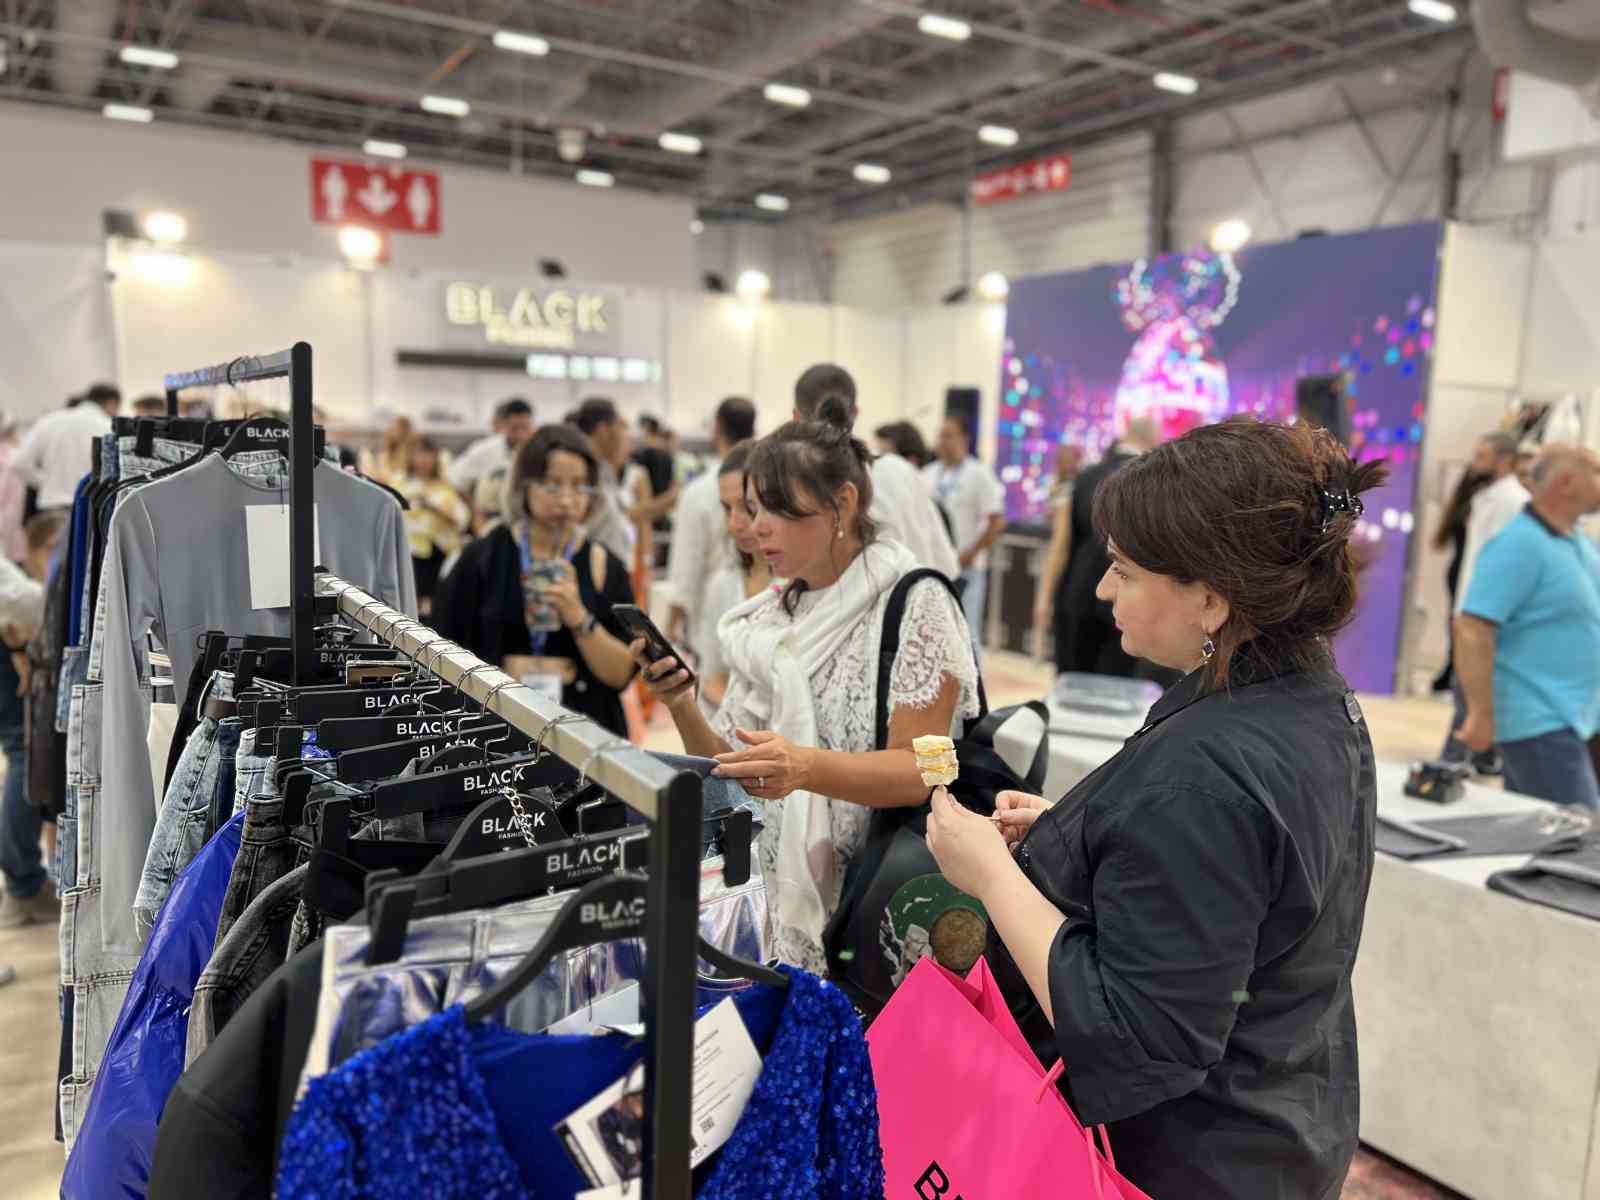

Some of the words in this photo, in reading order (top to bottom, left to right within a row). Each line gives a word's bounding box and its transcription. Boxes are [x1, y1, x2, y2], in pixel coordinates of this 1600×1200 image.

[446, 281, 609, 333] BLACK
[246, 427, 291, 438] BLACK
[396, 721, 452, 735] BLACK
[463, 767, 525, 792] BLACK
[481, 811, 546, 835] BLACK
[498, 830, 526, 841] FASHIO
[546, 843, 620, 874] BLACK
[580, 898, 646, 924] BLAC
[913, 1159, 964, 1200] B
